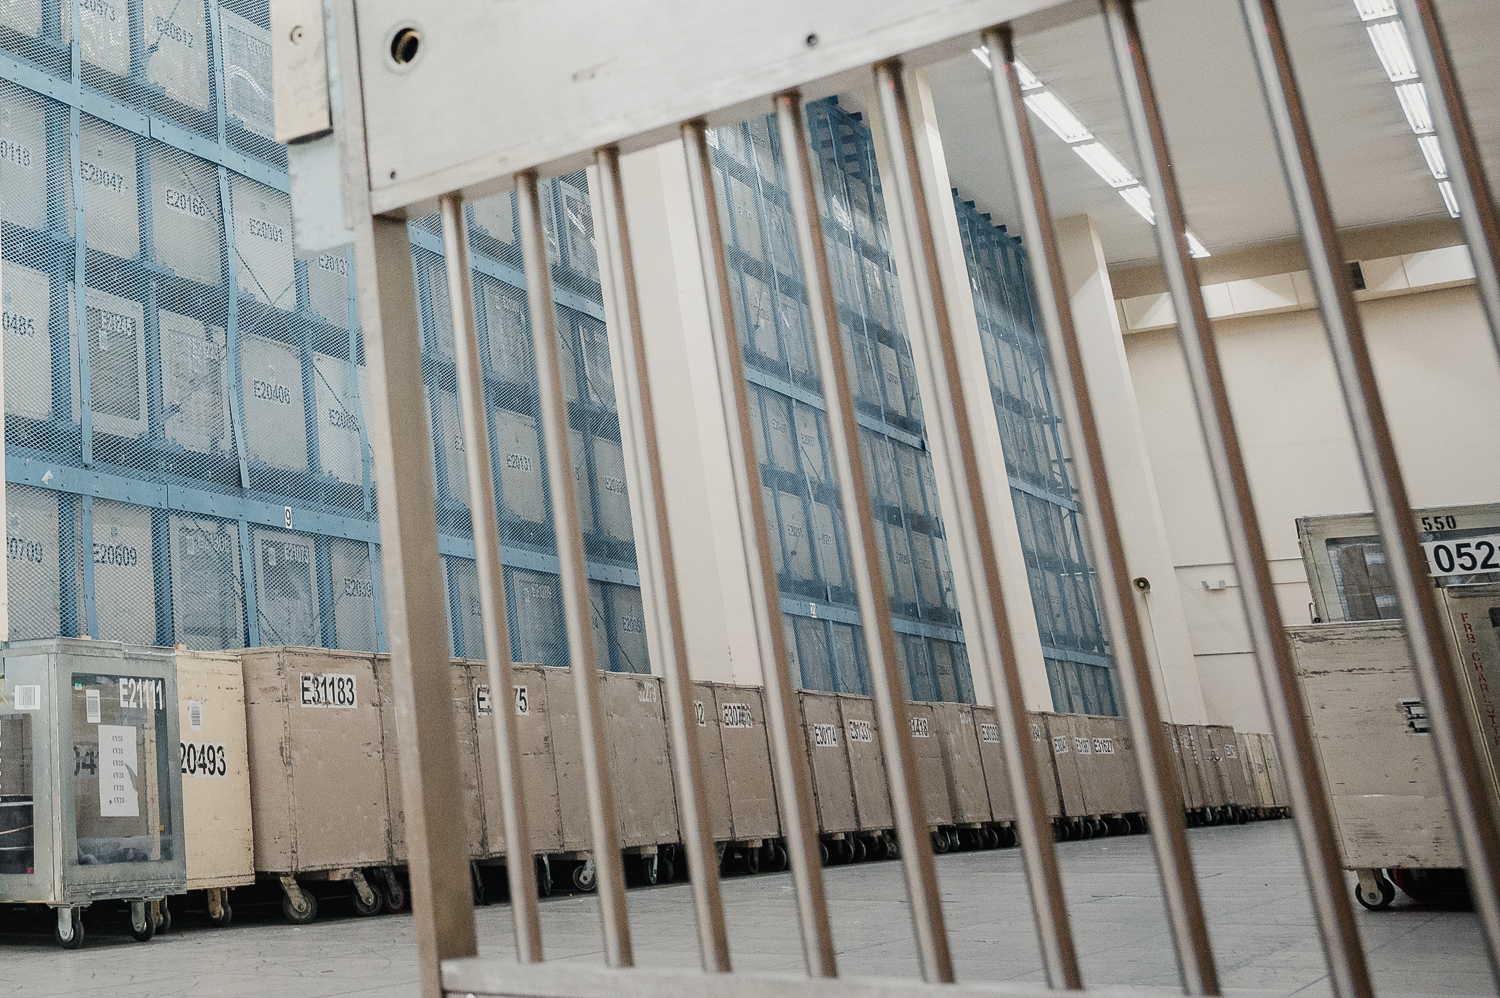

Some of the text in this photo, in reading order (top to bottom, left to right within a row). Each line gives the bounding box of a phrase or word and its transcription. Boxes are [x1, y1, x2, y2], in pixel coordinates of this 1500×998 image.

[285, 508, 292, 528] 9
[1421, 515, 1457, 532] 550
[118, 678, 163, 710] E21111
[301, 676, 355, 706] E31183
